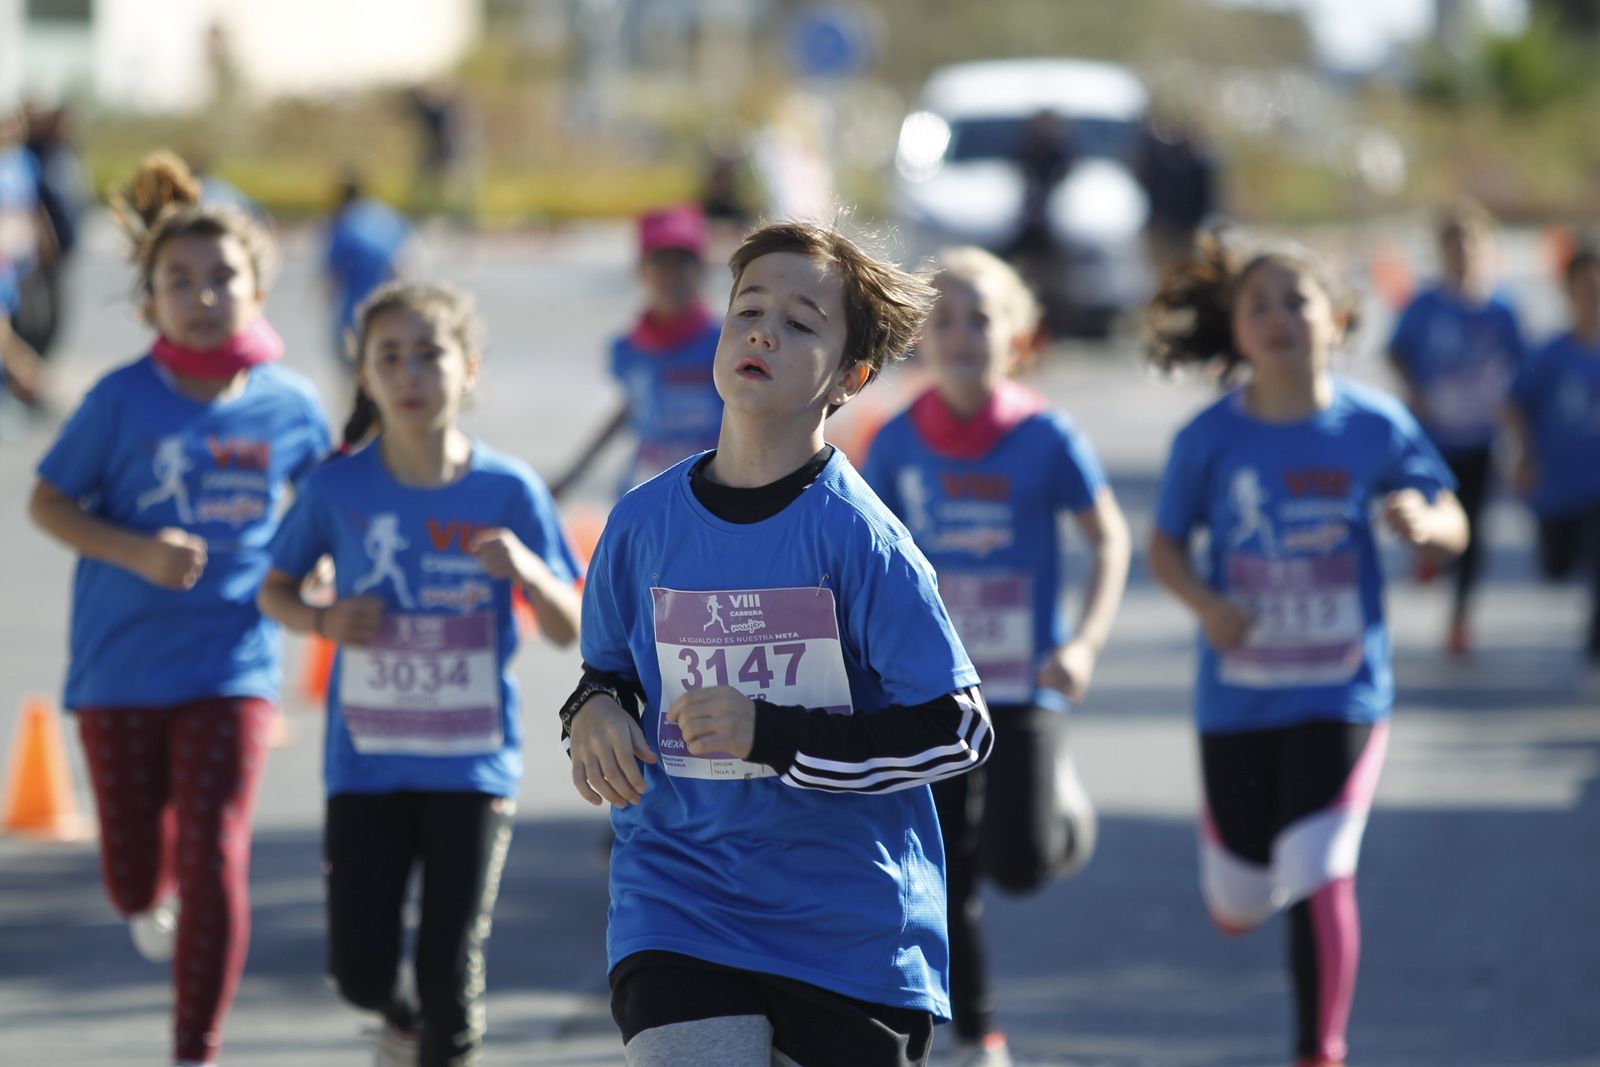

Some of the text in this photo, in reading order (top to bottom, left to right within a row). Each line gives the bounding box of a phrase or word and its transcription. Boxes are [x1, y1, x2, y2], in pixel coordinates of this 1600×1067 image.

[729, 594, 760, 608] VIII
[687, 636, 722, 644] IGUALDAD
[737, 635, 775, 643] NUESTRA
[775, 632, 799, 640] META
[367, 658, 471, 692] 3034
[678, 643, 806, 693] 3147
[660, 739, 684, 749] NEXA
